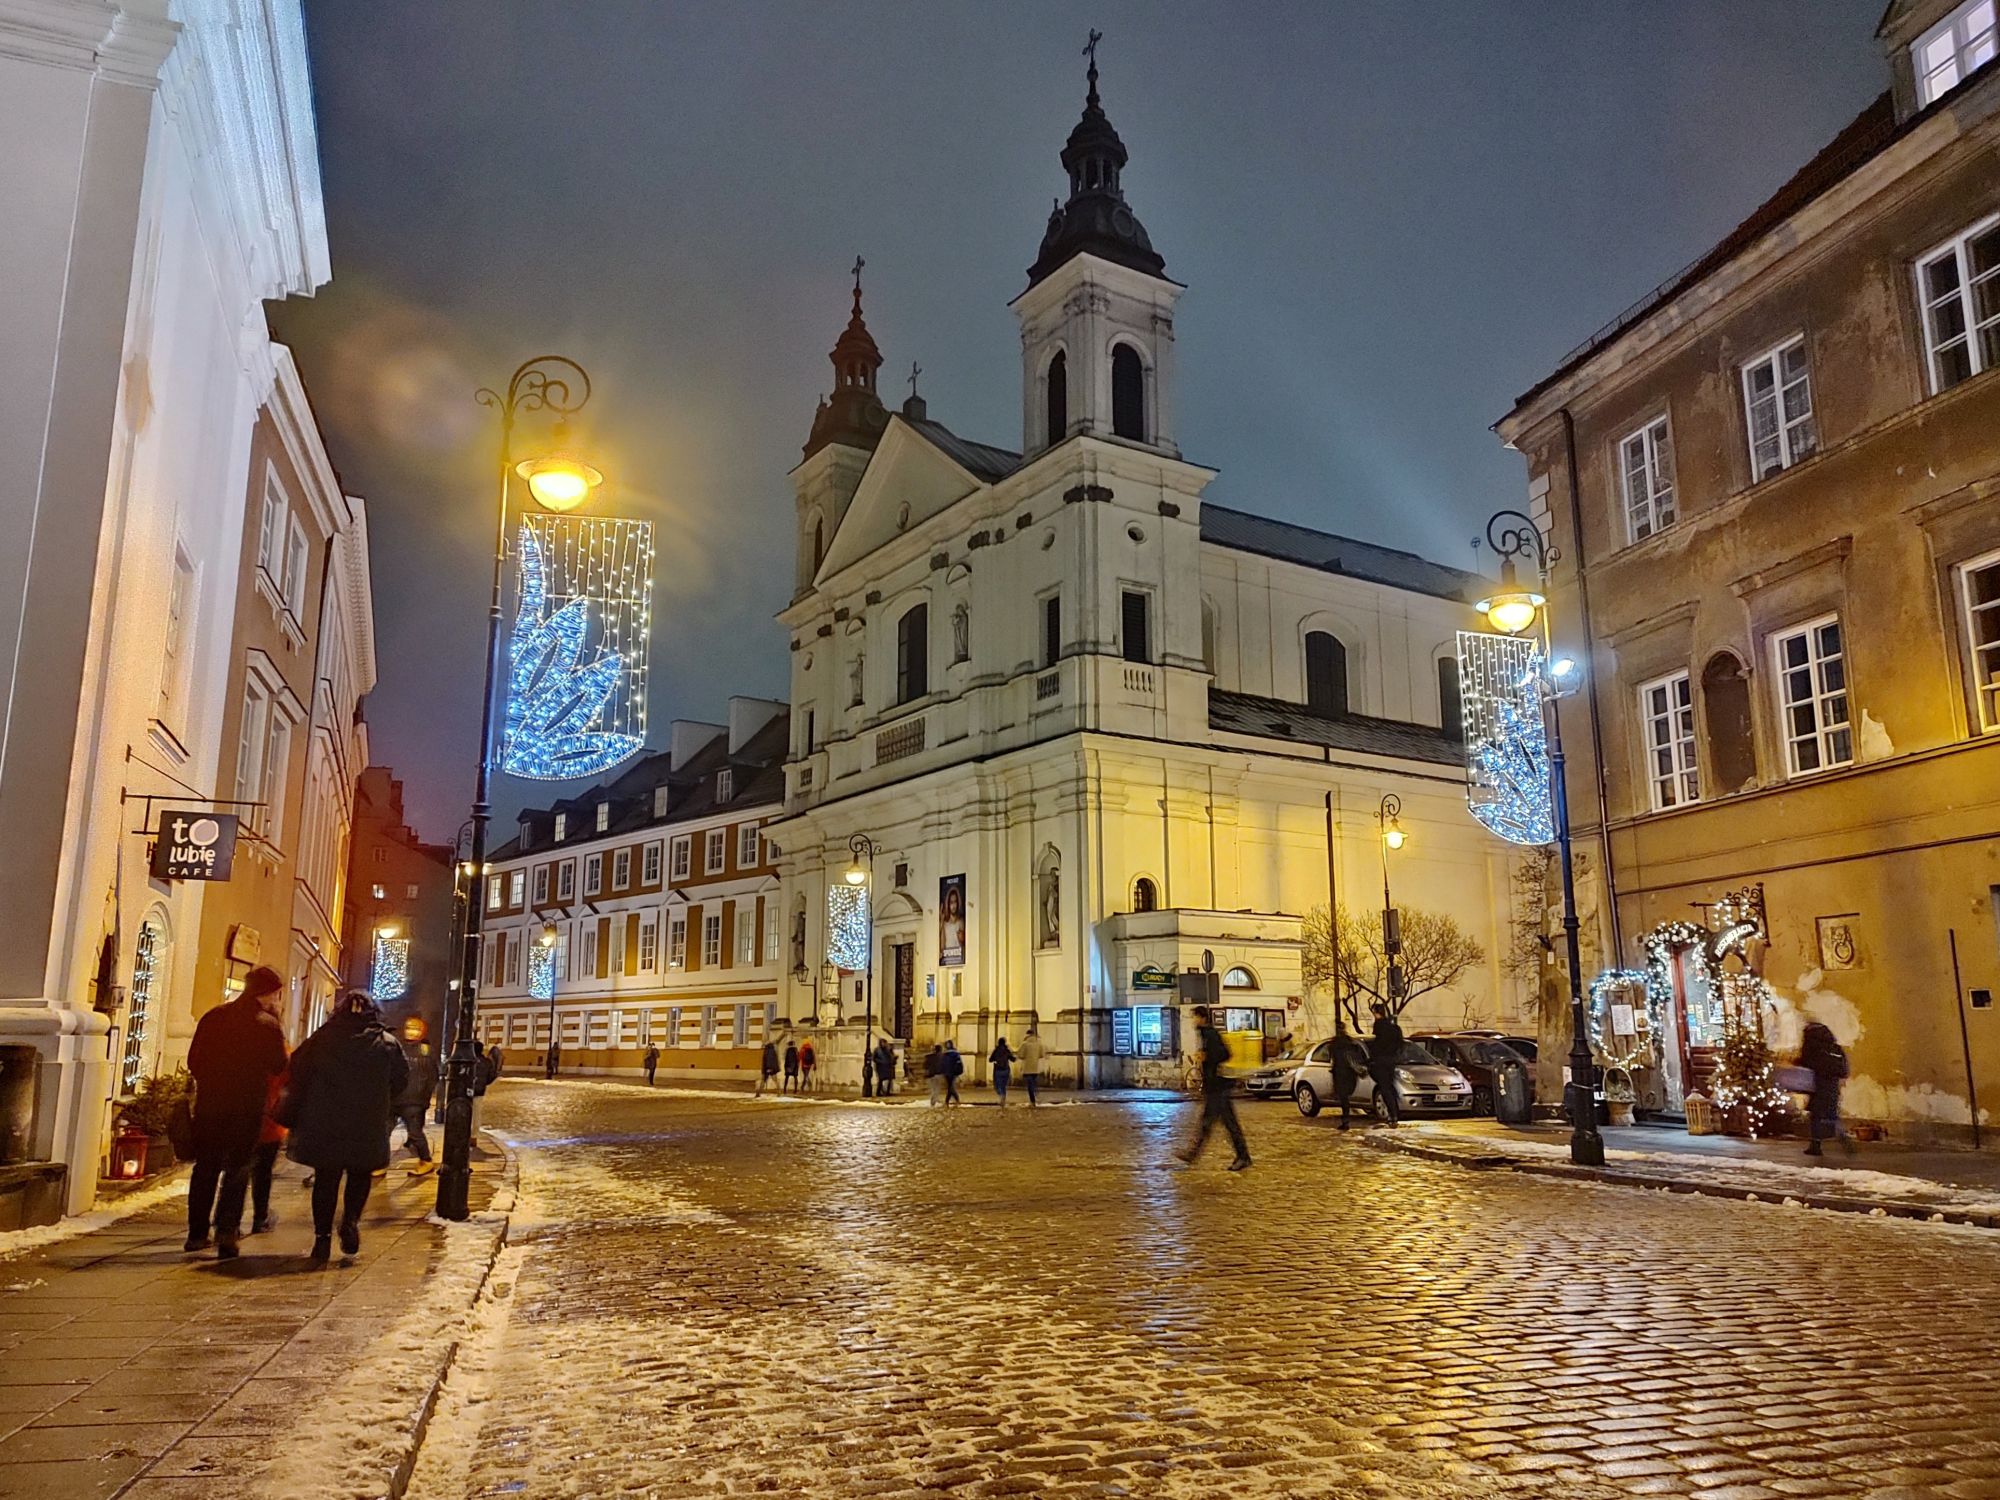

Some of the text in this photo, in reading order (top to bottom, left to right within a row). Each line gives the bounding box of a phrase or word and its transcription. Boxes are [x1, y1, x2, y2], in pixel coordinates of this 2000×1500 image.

[169, 845, 216, 866] lubię
[168, 867, 213, 876] CAFE
[1714, 923, 1756, 958] RESTAURACJA
